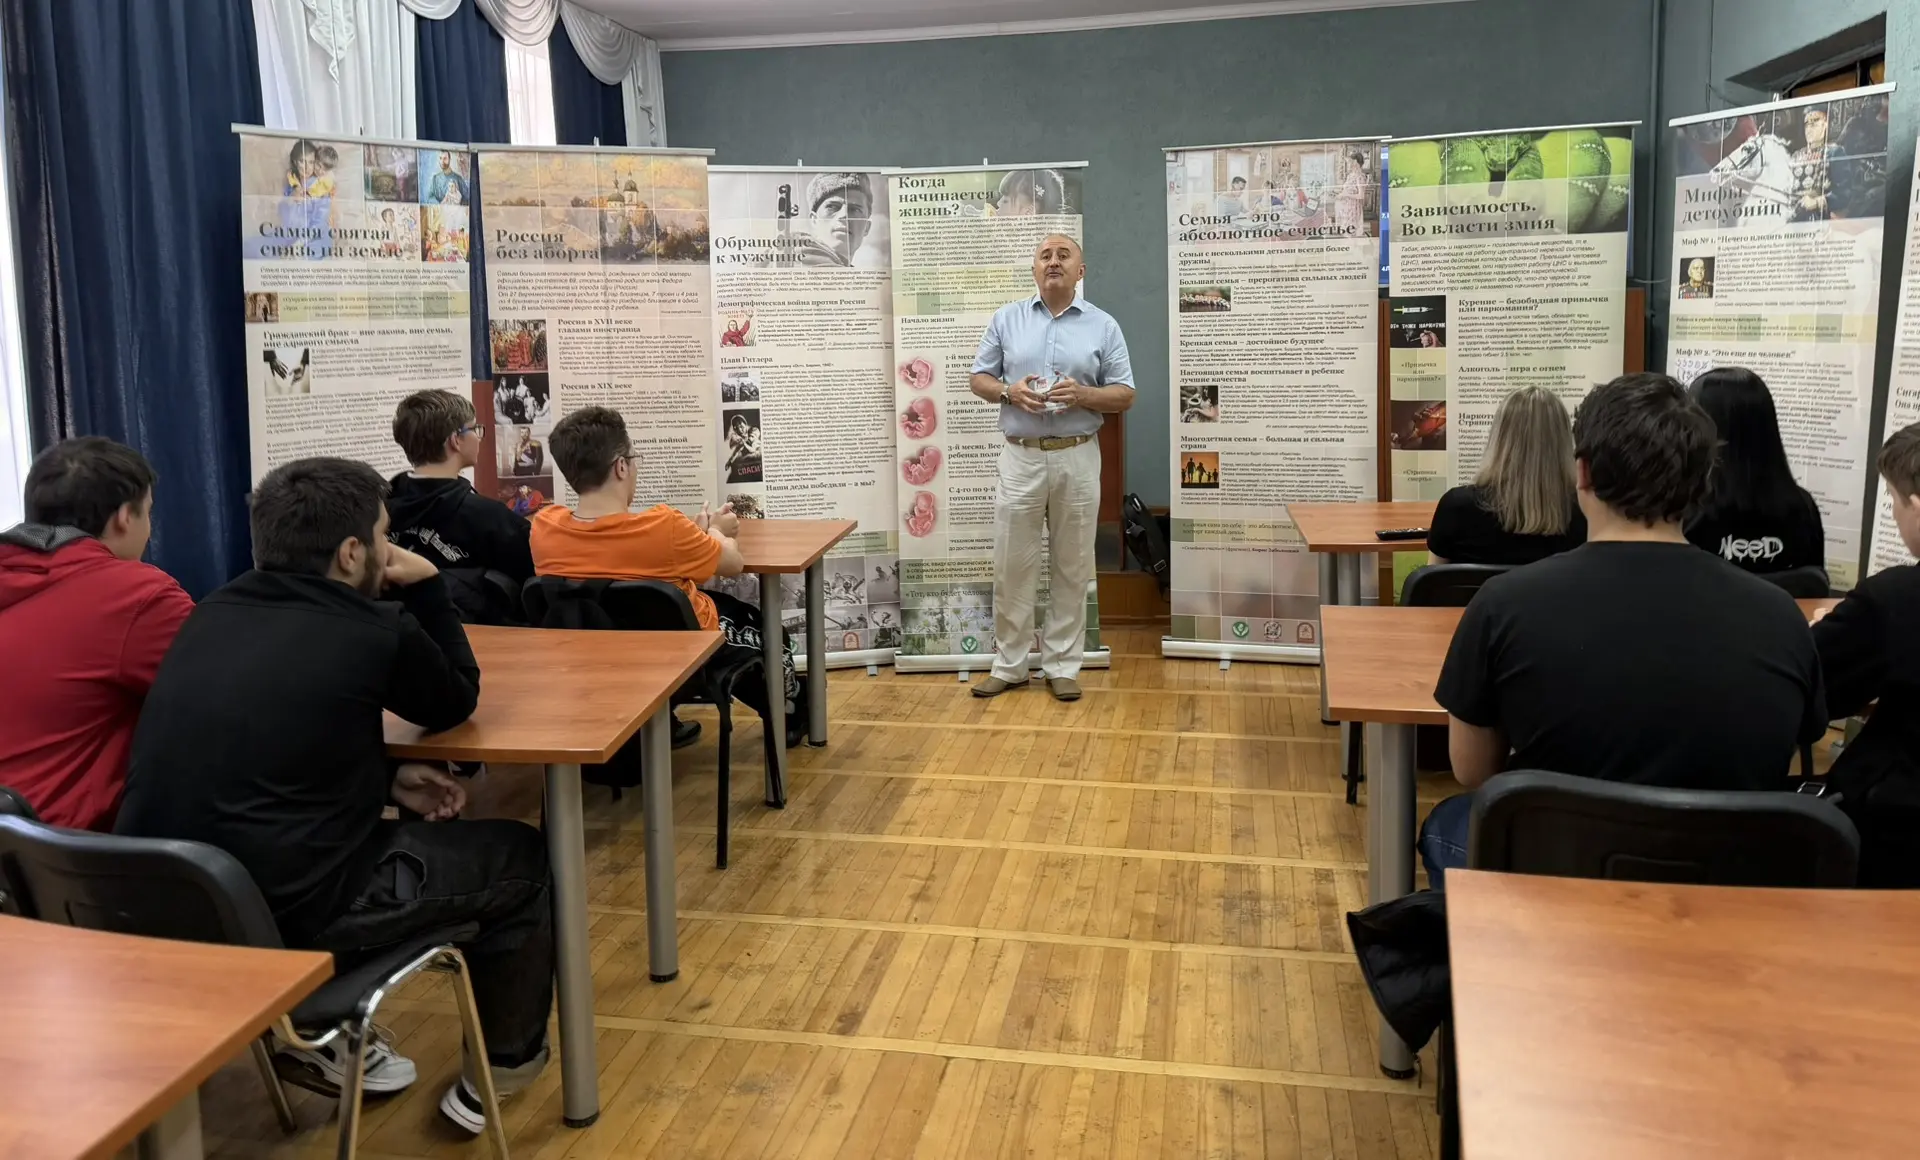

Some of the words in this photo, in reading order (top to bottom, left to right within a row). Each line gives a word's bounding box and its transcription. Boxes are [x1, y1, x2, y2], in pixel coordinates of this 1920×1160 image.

[899, 176, 945, 189] Когда
[899, 191, 994, 204] начинается
[1685, 186, 1743, 204] Мифы
[899, 203, 959, 217] жизнь?
[1401, 202, 1537, 219] Зависимость.
[1683, 199, 1782, 224] детоубийц
[1179, 213, 1232, 227] Семья
[1252, 213, 1280, 223] это
[259, 221, 322, 239] Самая
[329, 226, 390, 239] святая
[1179, 227, 1283, 242] абсолютное
[1288, 225, 1356, 237] счастье
[1402, 222, 1425, 237] Во
[1431, 221, 1498, 235] власти
[1504, 219, 1555, 232] змия
[496, 229, 563, 243] Россия
[1682, 238, 1699, 246] Миф
[1750, 233, 1782, 242] плодить
[715, 236, 812, 250] Обращение
[260, 245, 315, 257] связь
[321, 247, 343, 258] на
[349, 246, 403, 258] земле
[497, 246, 527, 260] без
[533, 247, 599, 262] аборта
[716, 255, 725, 264] к
[730, 253, 806, 265] мужчине
[1179, 258, 1210, 266] дружны
[1248, 276, 1300, 285] прерогатива
[1339, 273, 1367, 281] людей
[718, 300, 785, 308] Демографическая
[1459, 299, 1496, 307] Курение
[1506, 297, 1559, 305] безобидная
[1478, 304, 1539, 313] наркомания?
[263, 329, 325, 340] Гражданский
[327, 328, 350, 339] брак
[263, 340, 281, 348] вне
[283, 339, 324, 347] здравого
[1246, 338, 1288, 346] достойное
[1290, 338, 1324, 346] будущее
[1676, 348, 1692, 356] Миф
[743, 356, 773, 364] Гитлера
[1180, 369, 1224, 377] Настоящая
[1311, 368, 1345, 377] ребенке
[1896, 386, 1920, 400] Сигар
[1895, 400, 1911, 408] Она
[633, 437, 656, 445] ровой
[766, 484, 789, 492] Наши
[811, 482, 846, 490] победили
[940, 589, 961, 599] будет
